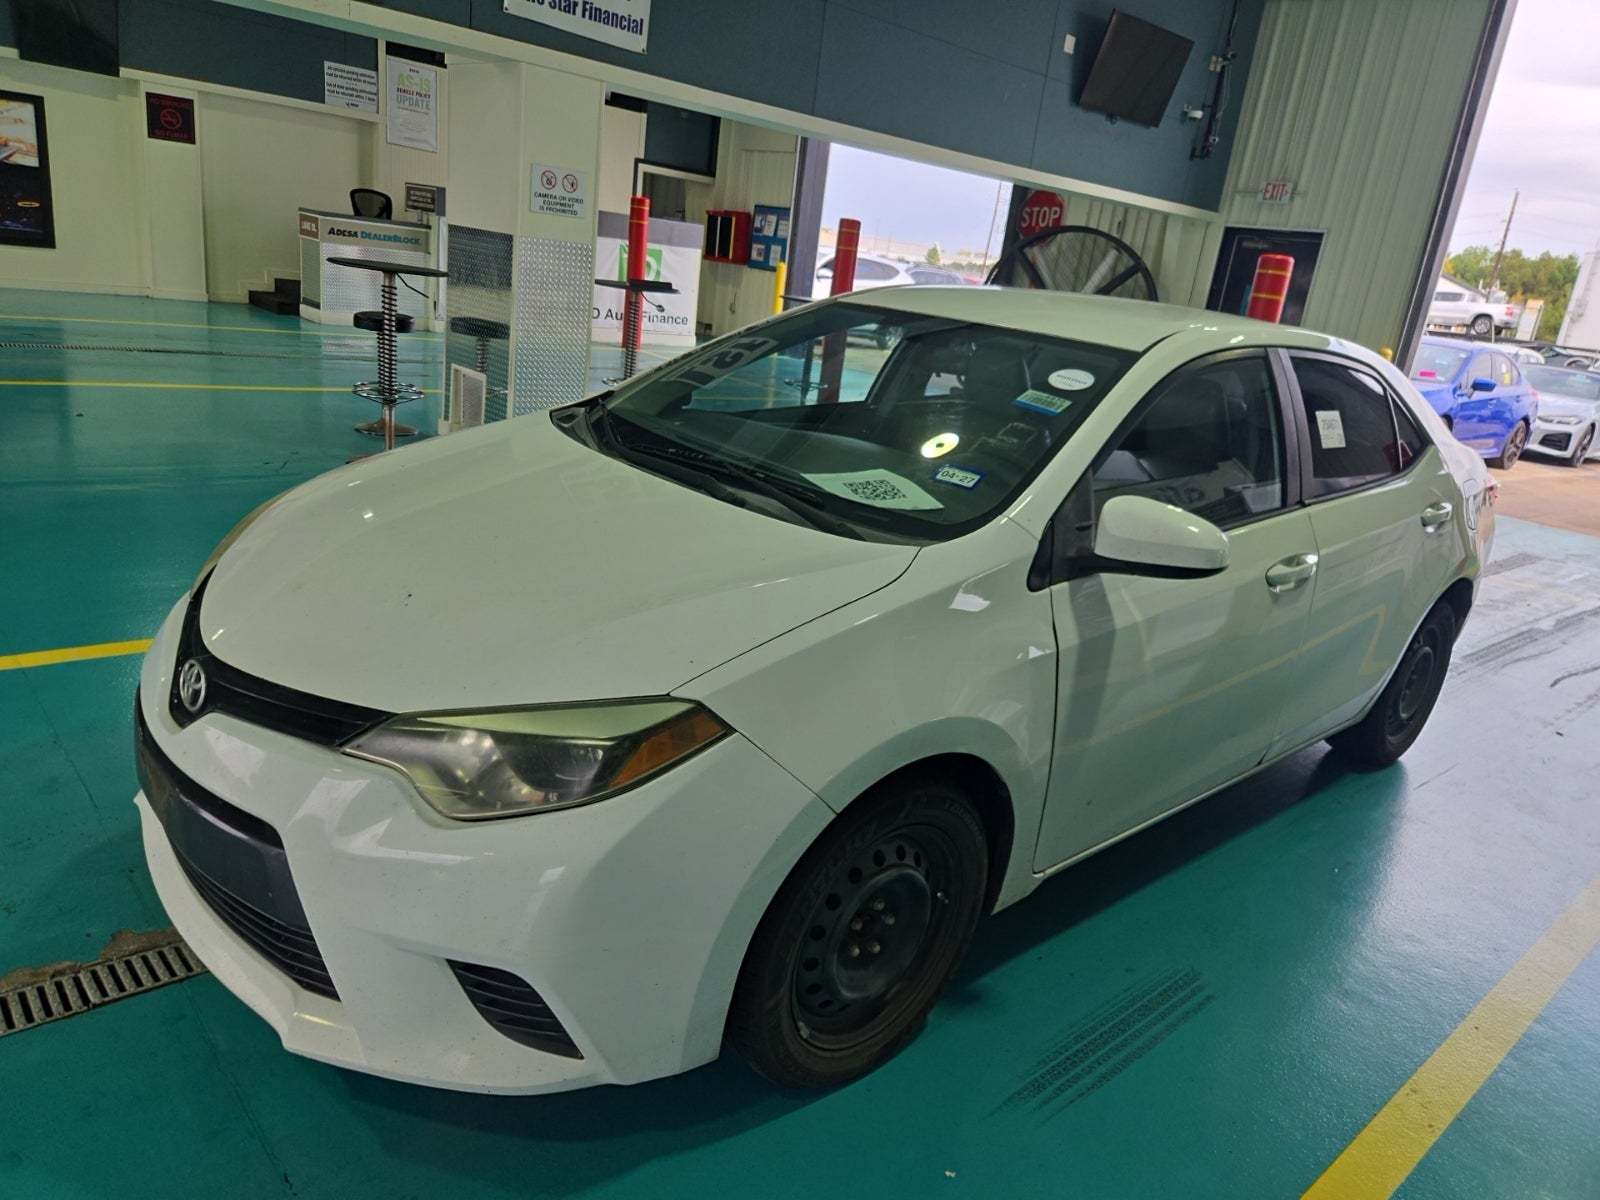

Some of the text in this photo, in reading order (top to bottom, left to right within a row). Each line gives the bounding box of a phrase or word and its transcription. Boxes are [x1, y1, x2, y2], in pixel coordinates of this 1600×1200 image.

[581, 0, 645, 36] Financial
[397, 71, 431, 93] AS-IS
[415, 91, 431, 99] POLICY
[396, 94, 431, 111] UPDATE
[533, 191, 557, 200] CAMERA
[568, 196, 584, 205] VIDEO
[1262, 182, 1287, 201] EXIT
[542, 199, 575, 209] EQUIPMENT
[545, 206, 578, 216] PROHIBITED
[1020, 206, 1061, 228] STOP
[592, 307, 601, 320] D
[604, 308, 624, 321] Au
[940, 470, 975, 484] 04 27
